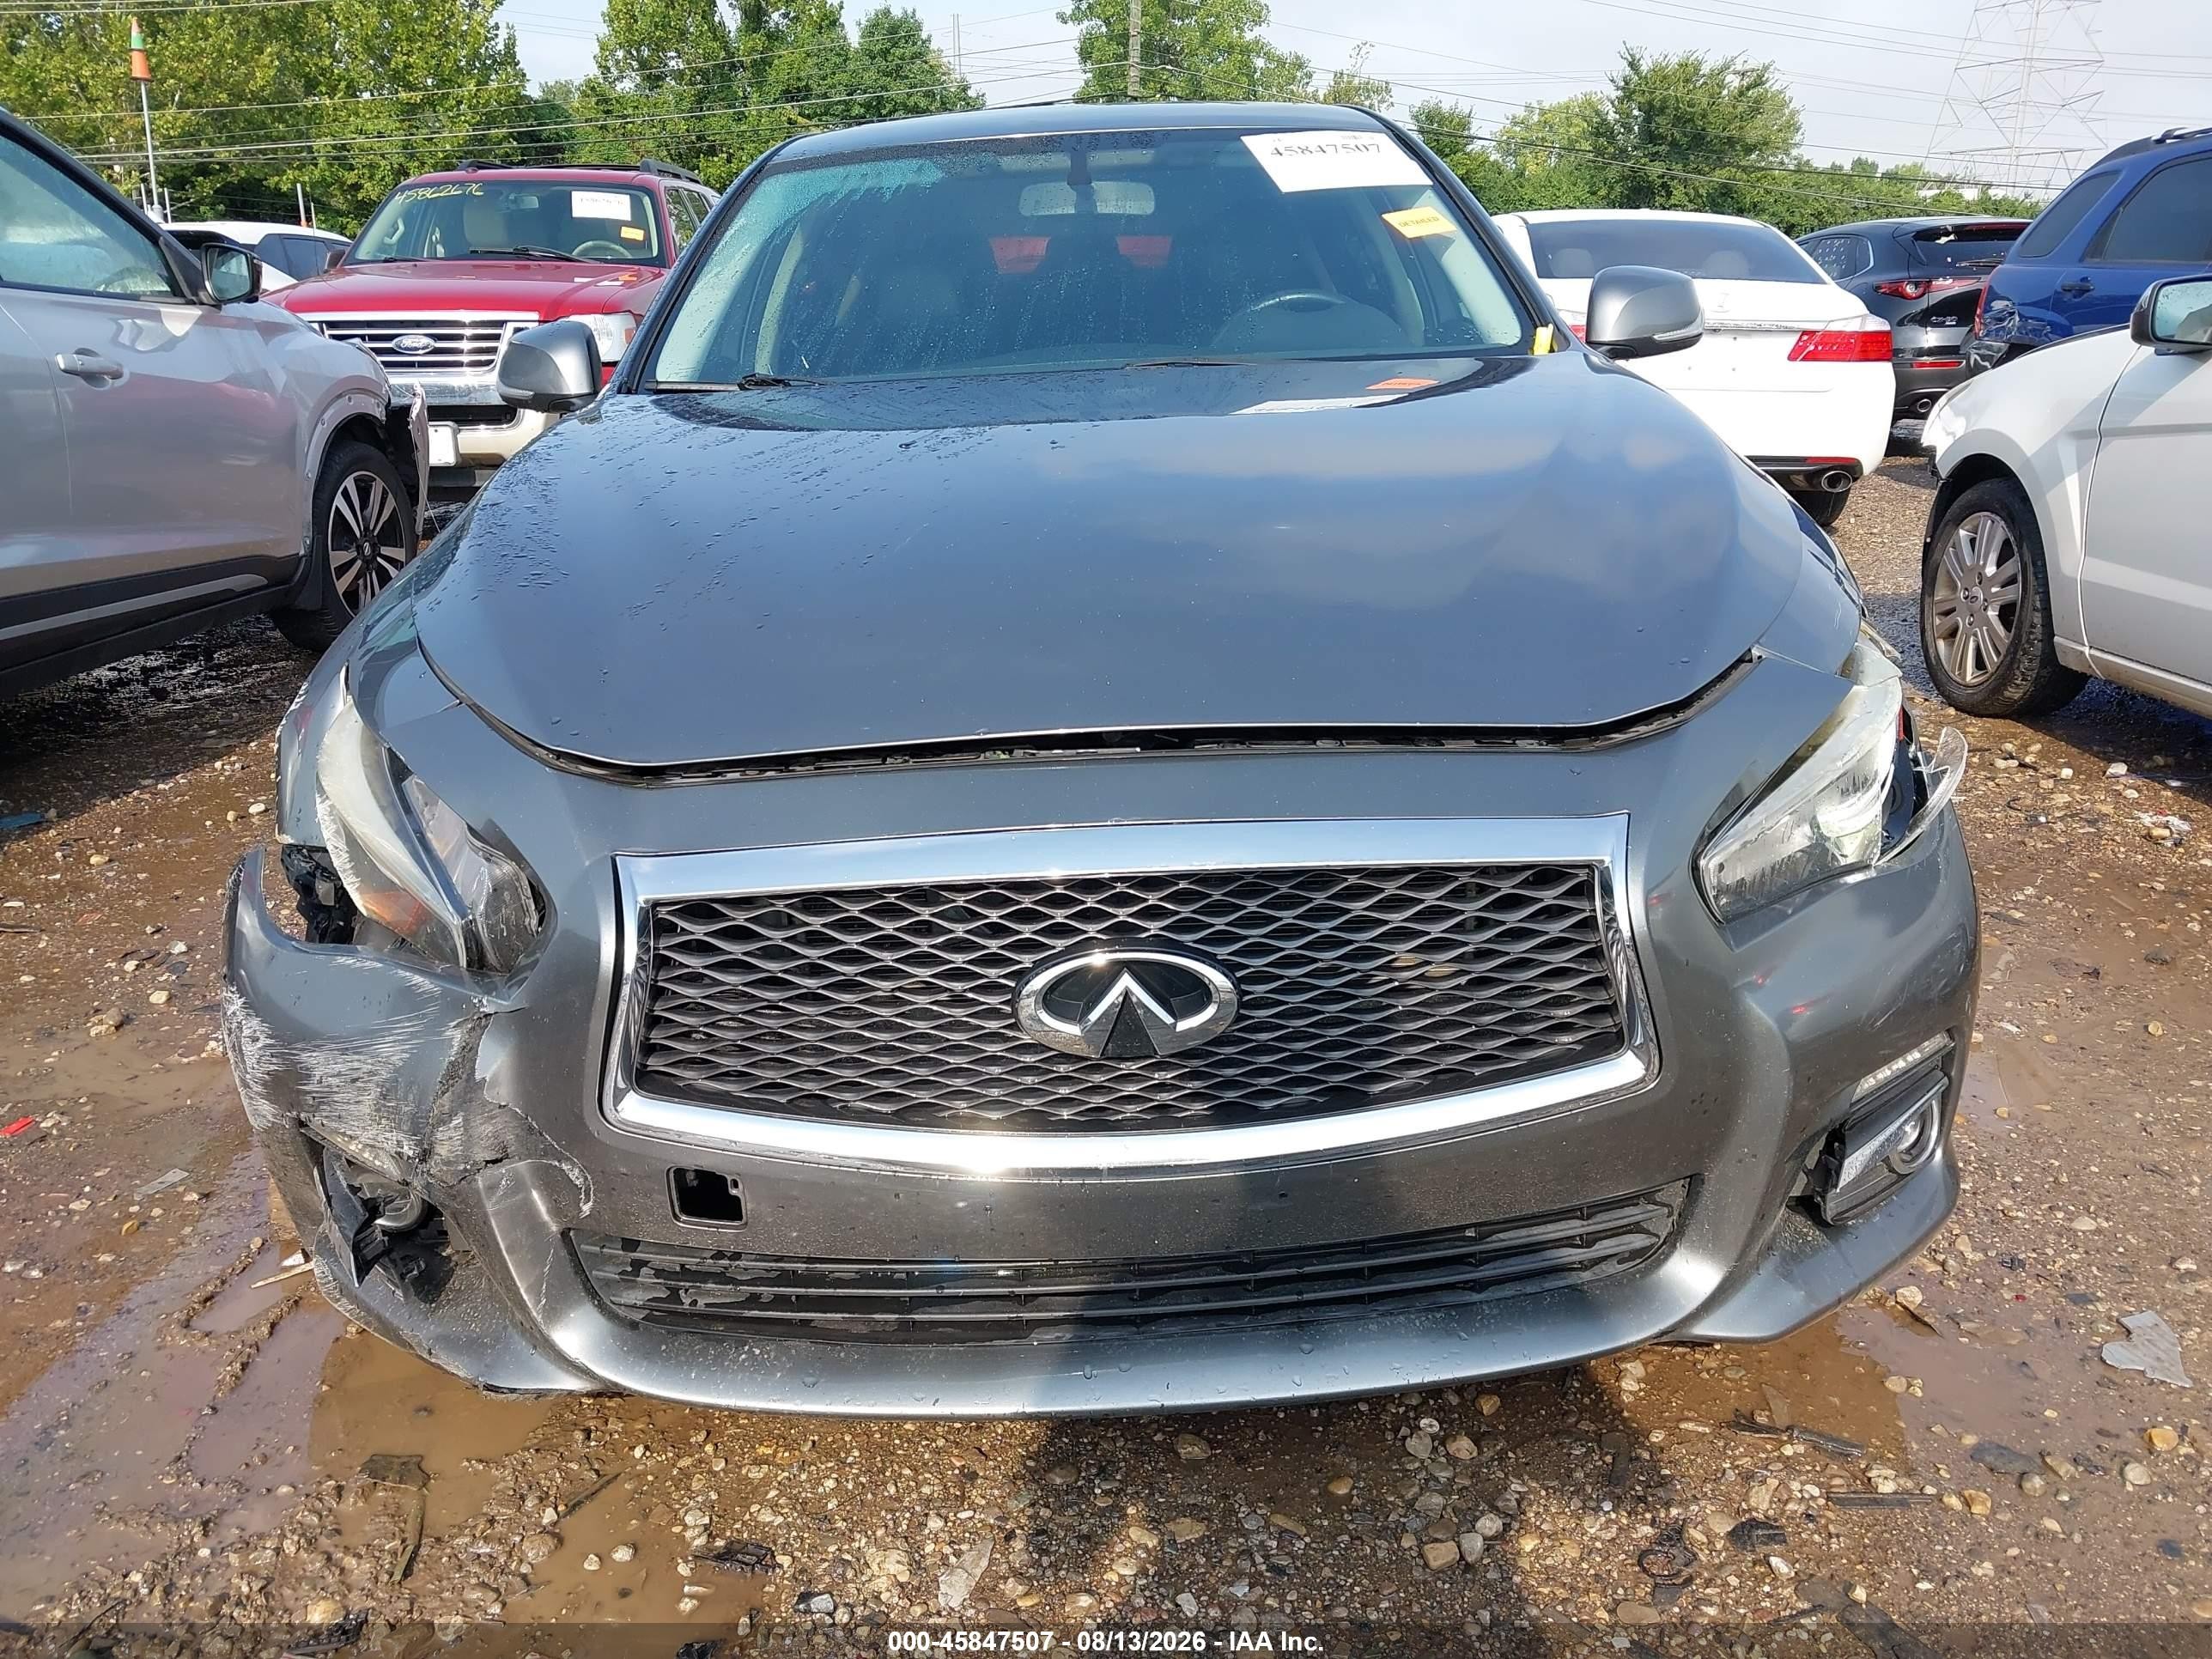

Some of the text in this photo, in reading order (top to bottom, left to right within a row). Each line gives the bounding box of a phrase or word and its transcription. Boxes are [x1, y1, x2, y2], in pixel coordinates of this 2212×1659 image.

[1271, 143, 1381, 156] 45847507
[394, 183, 484, 204] 45862676
[1398, 216, 1439, 227] DETAILED
